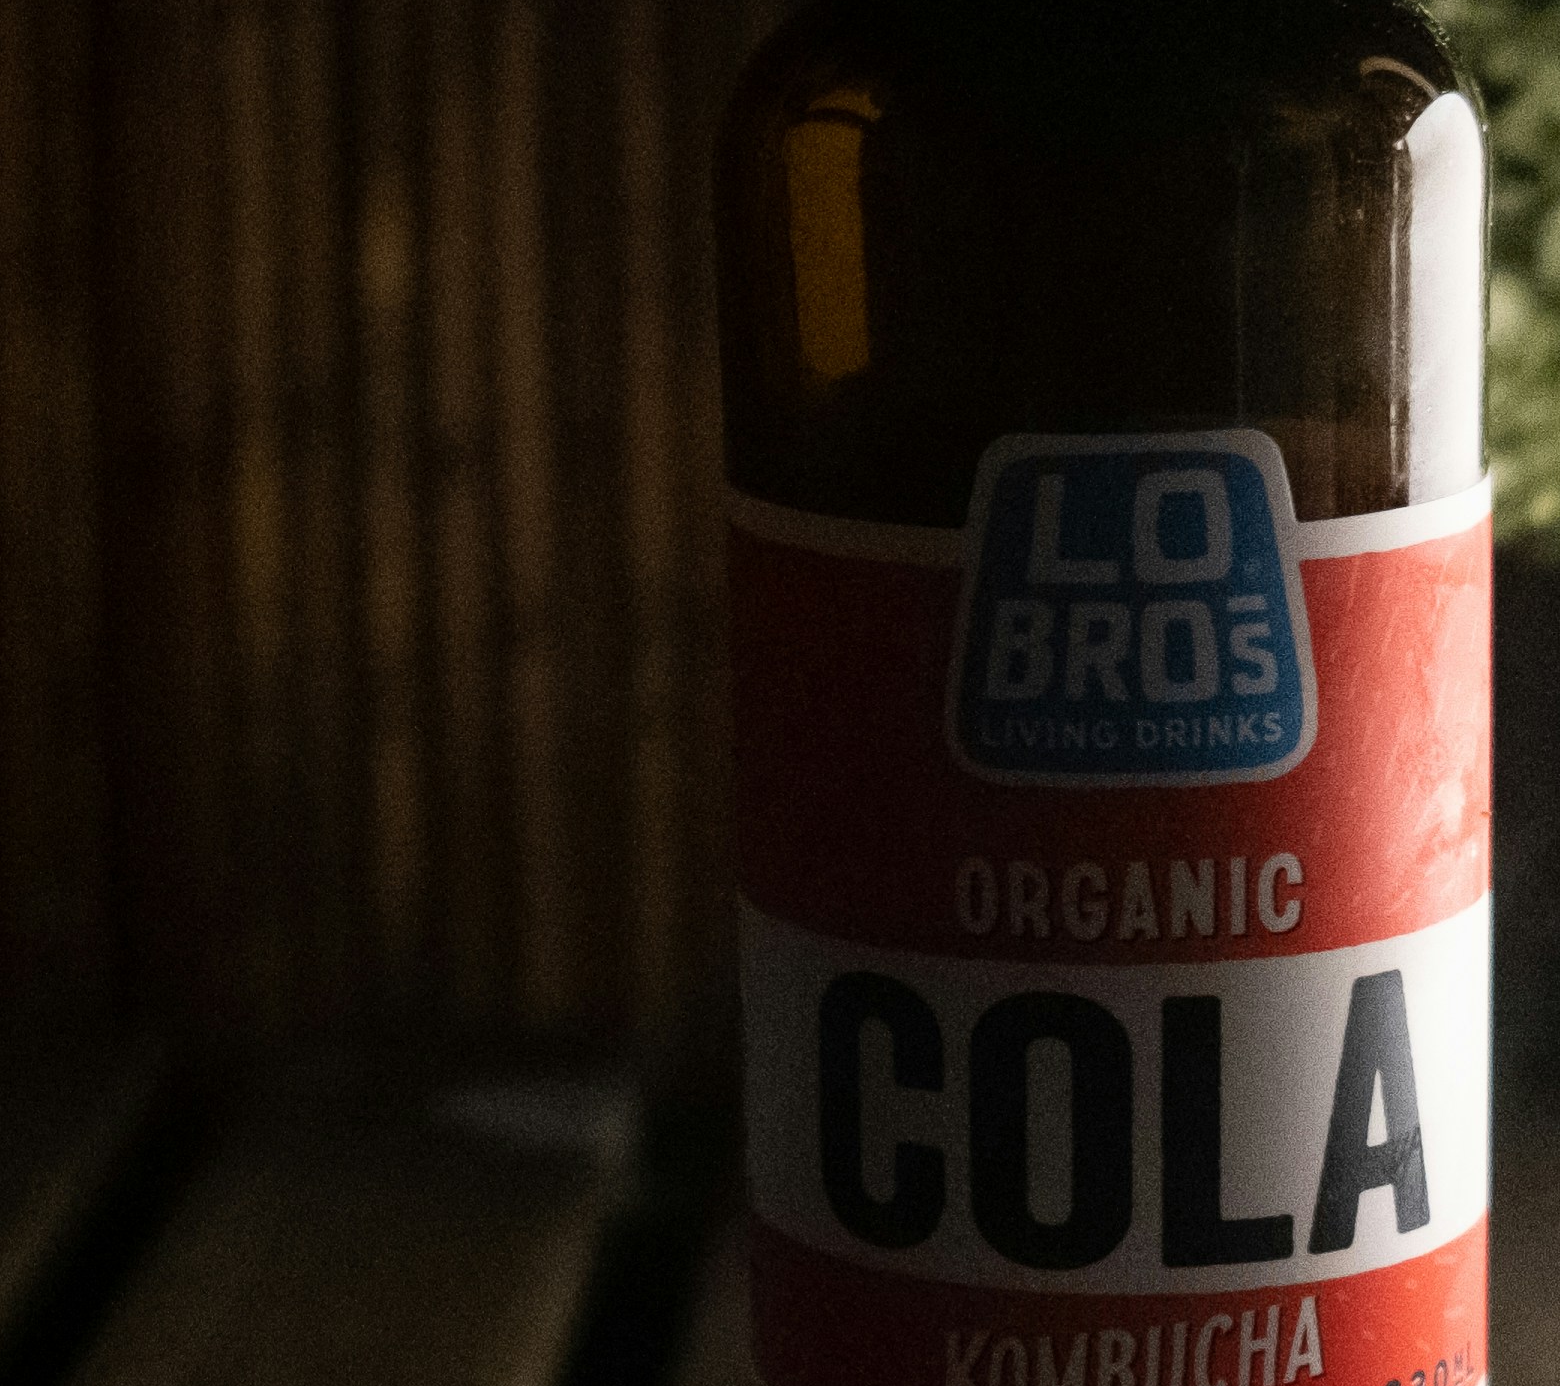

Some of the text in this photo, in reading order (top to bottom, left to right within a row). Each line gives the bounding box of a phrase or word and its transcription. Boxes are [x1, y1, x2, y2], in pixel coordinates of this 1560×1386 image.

[1026, 467, 1233, 587] LO
[981, 710, 1284, 751] LIVING DRINKS
[954, 851, 1306, 942] ORGANIC
[817, 968, 1432, 1271] COLA
